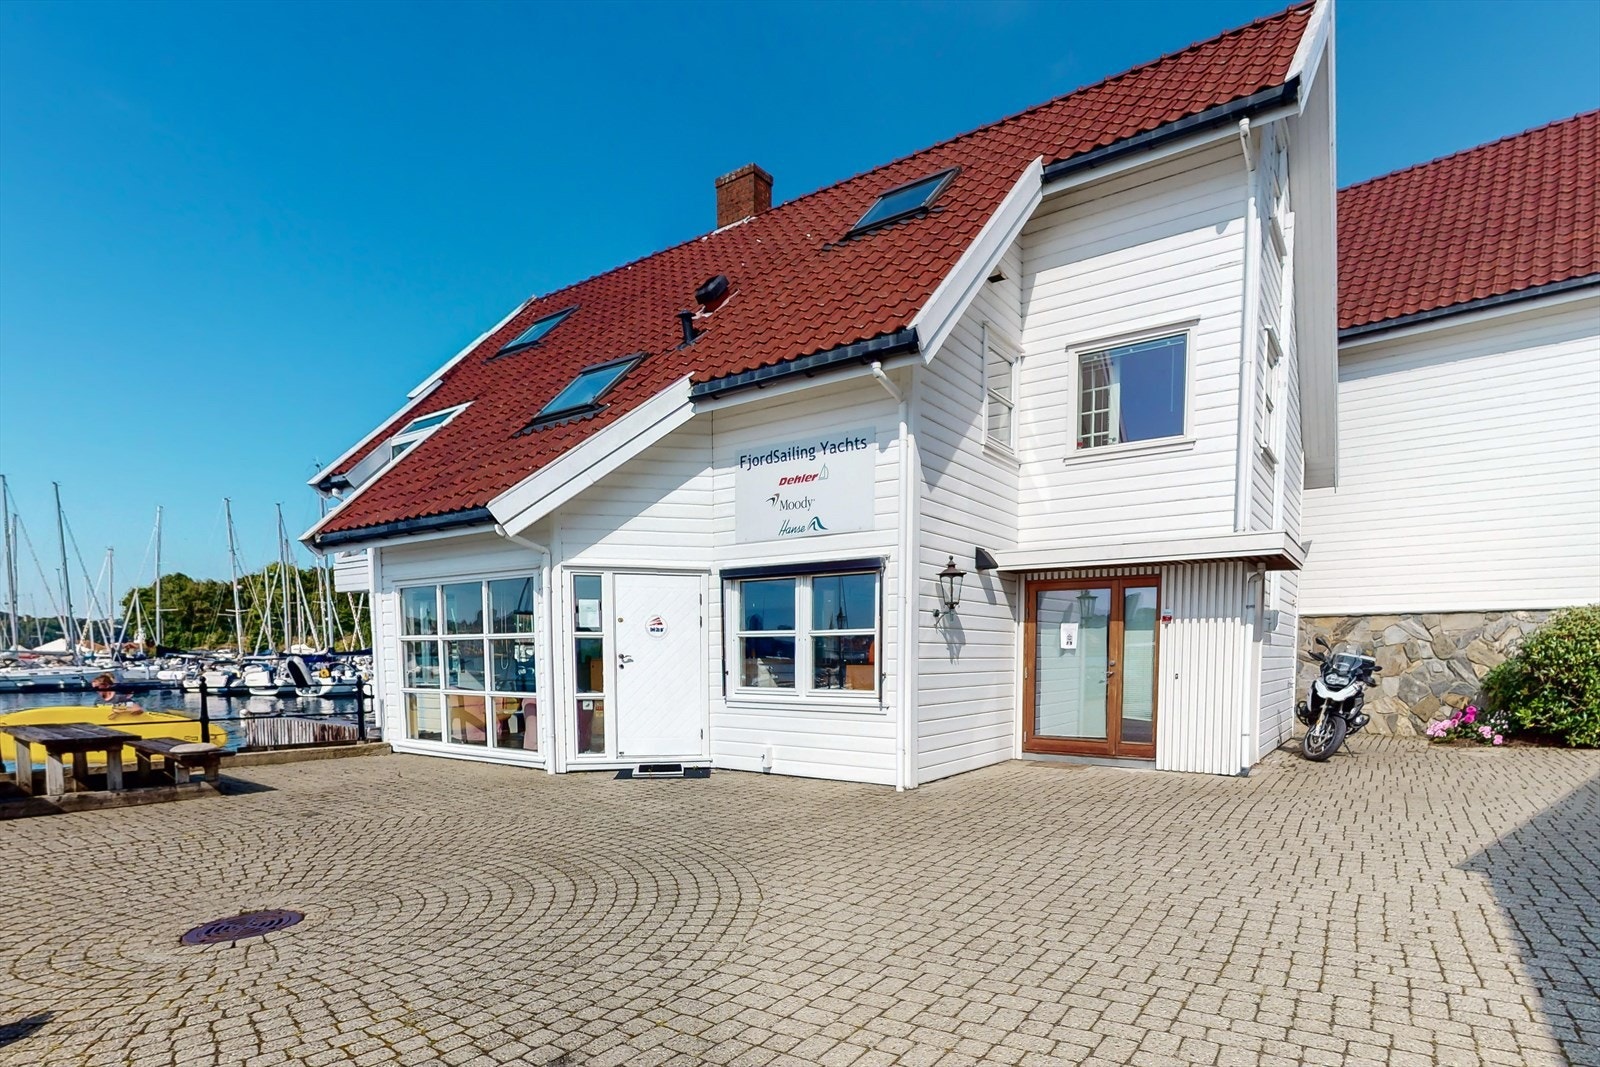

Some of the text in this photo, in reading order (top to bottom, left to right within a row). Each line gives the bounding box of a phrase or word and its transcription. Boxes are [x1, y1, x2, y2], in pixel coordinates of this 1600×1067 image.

[740, 437, 867, 471] FjordSailing Yachts
[778, 473, 819, 486] Dehler
[779, 496, 812, 511] Moody
[778, 519, 806, 536] Hanse
